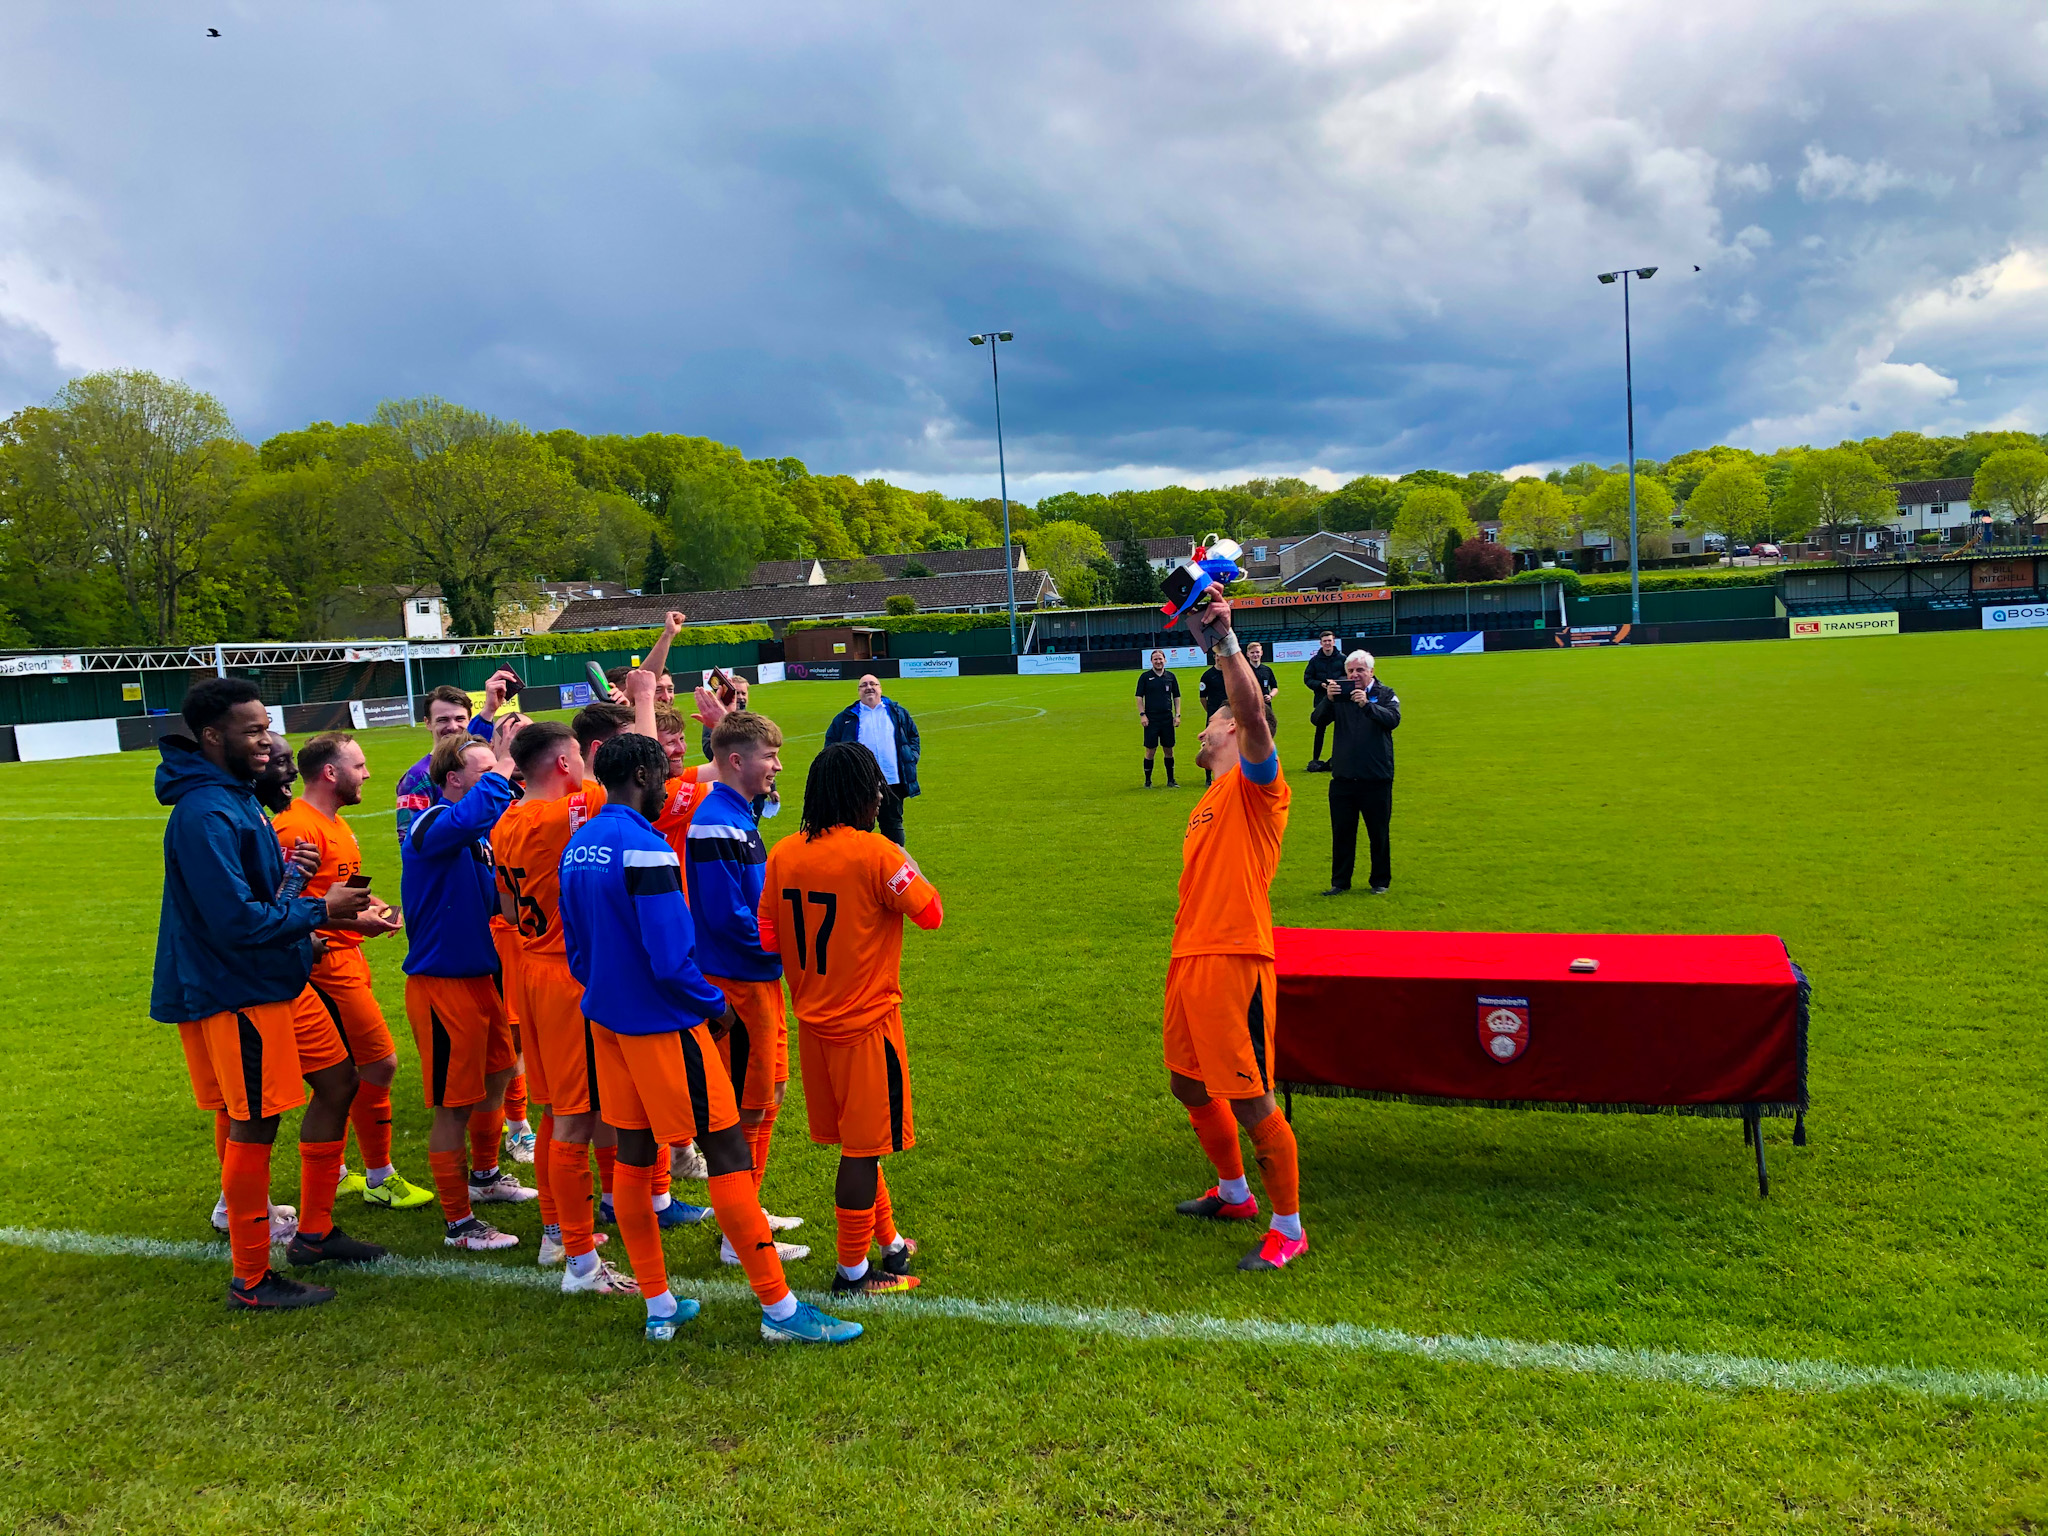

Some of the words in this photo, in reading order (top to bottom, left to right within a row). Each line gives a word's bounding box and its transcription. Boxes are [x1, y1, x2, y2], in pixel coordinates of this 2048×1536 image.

[1979, 574, 2027, 583] MITCHELL
[1261, 595, 1300, 606] GERRY
[1302, 592, 1344, 603] WYKES
[1346, 592, 1374, 600] STAND
[1797, 623, 1818, 632] CSL
[1824, 619, 1895, 631] TRANSPORT
[1414, 635, 1445, 651] AJC
[563, 845, 613, 866] BOSS
[782, 888, 837, 976] 17
